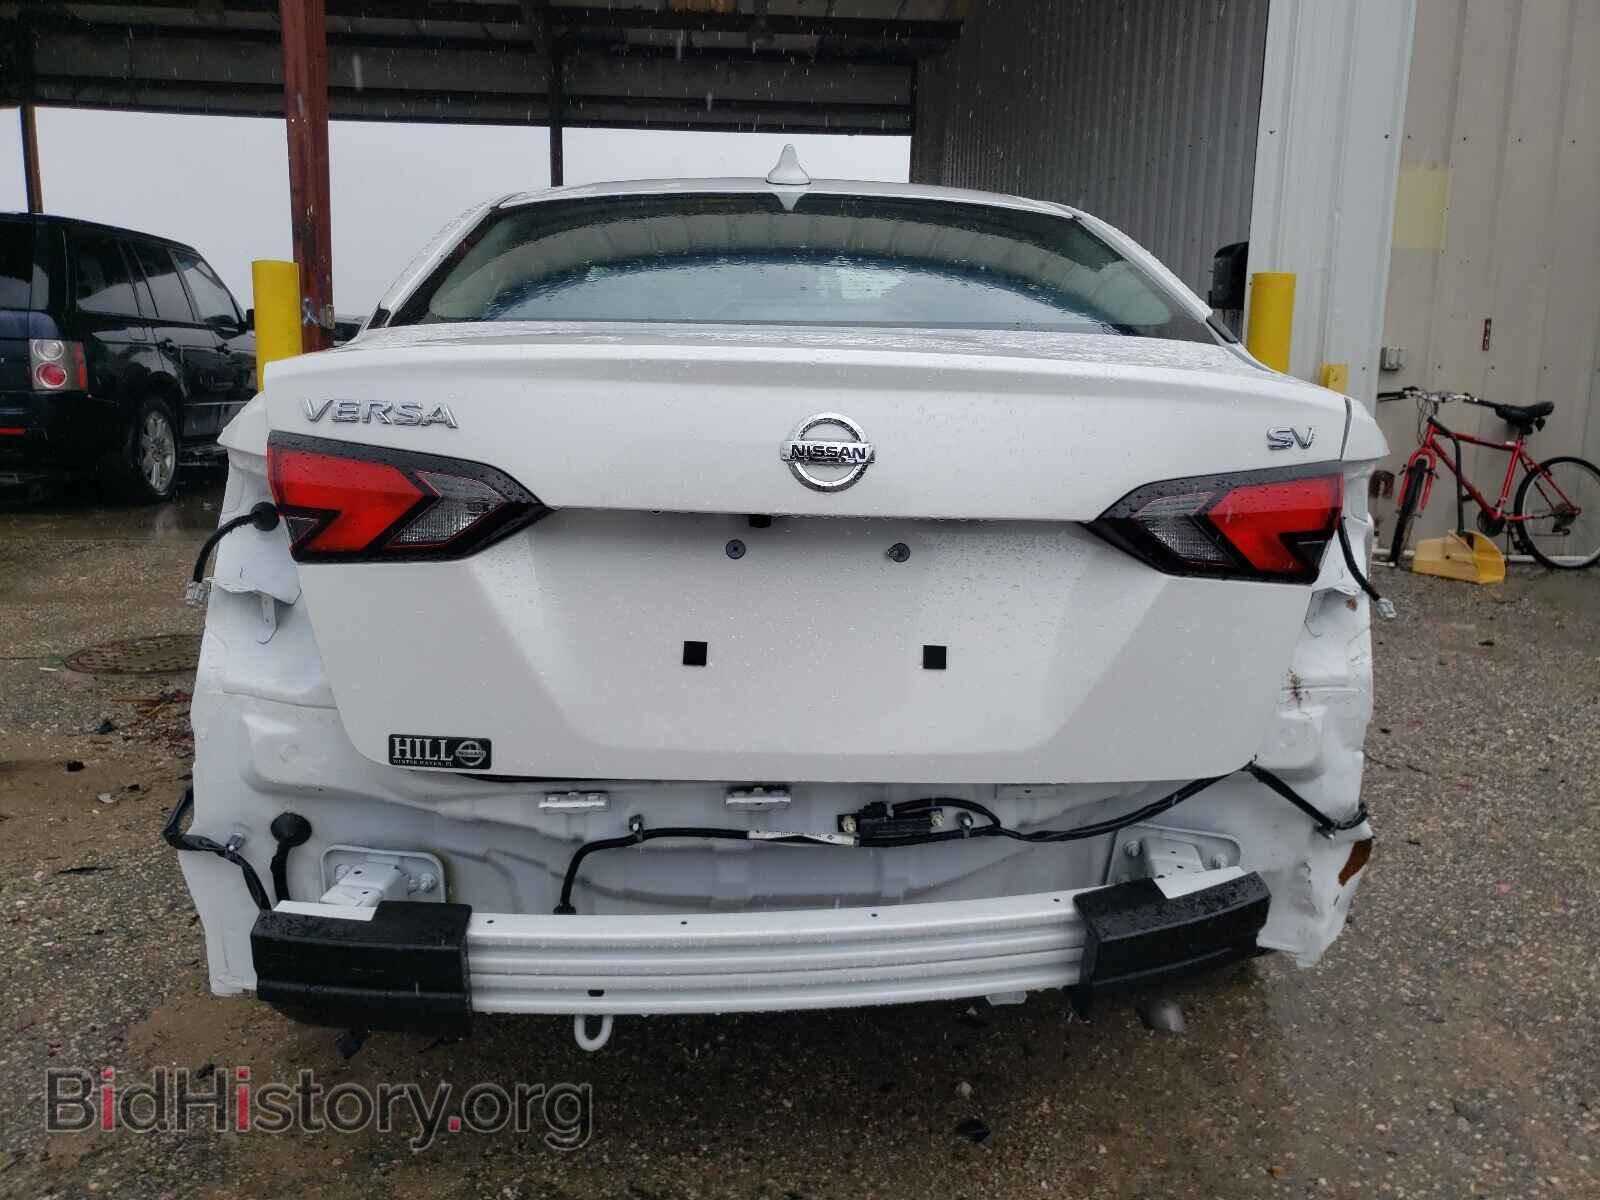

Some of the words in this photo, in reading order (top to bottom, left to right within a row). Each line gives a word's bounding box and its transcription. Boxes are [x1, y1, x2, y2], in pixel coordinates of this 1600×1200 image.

[304, 399, 458, 429] VERSA
[1266, 426, 1314, 451] SV
[790, 444, 867, 461] NISSAN
[392, 737, 454, 761] HILL
